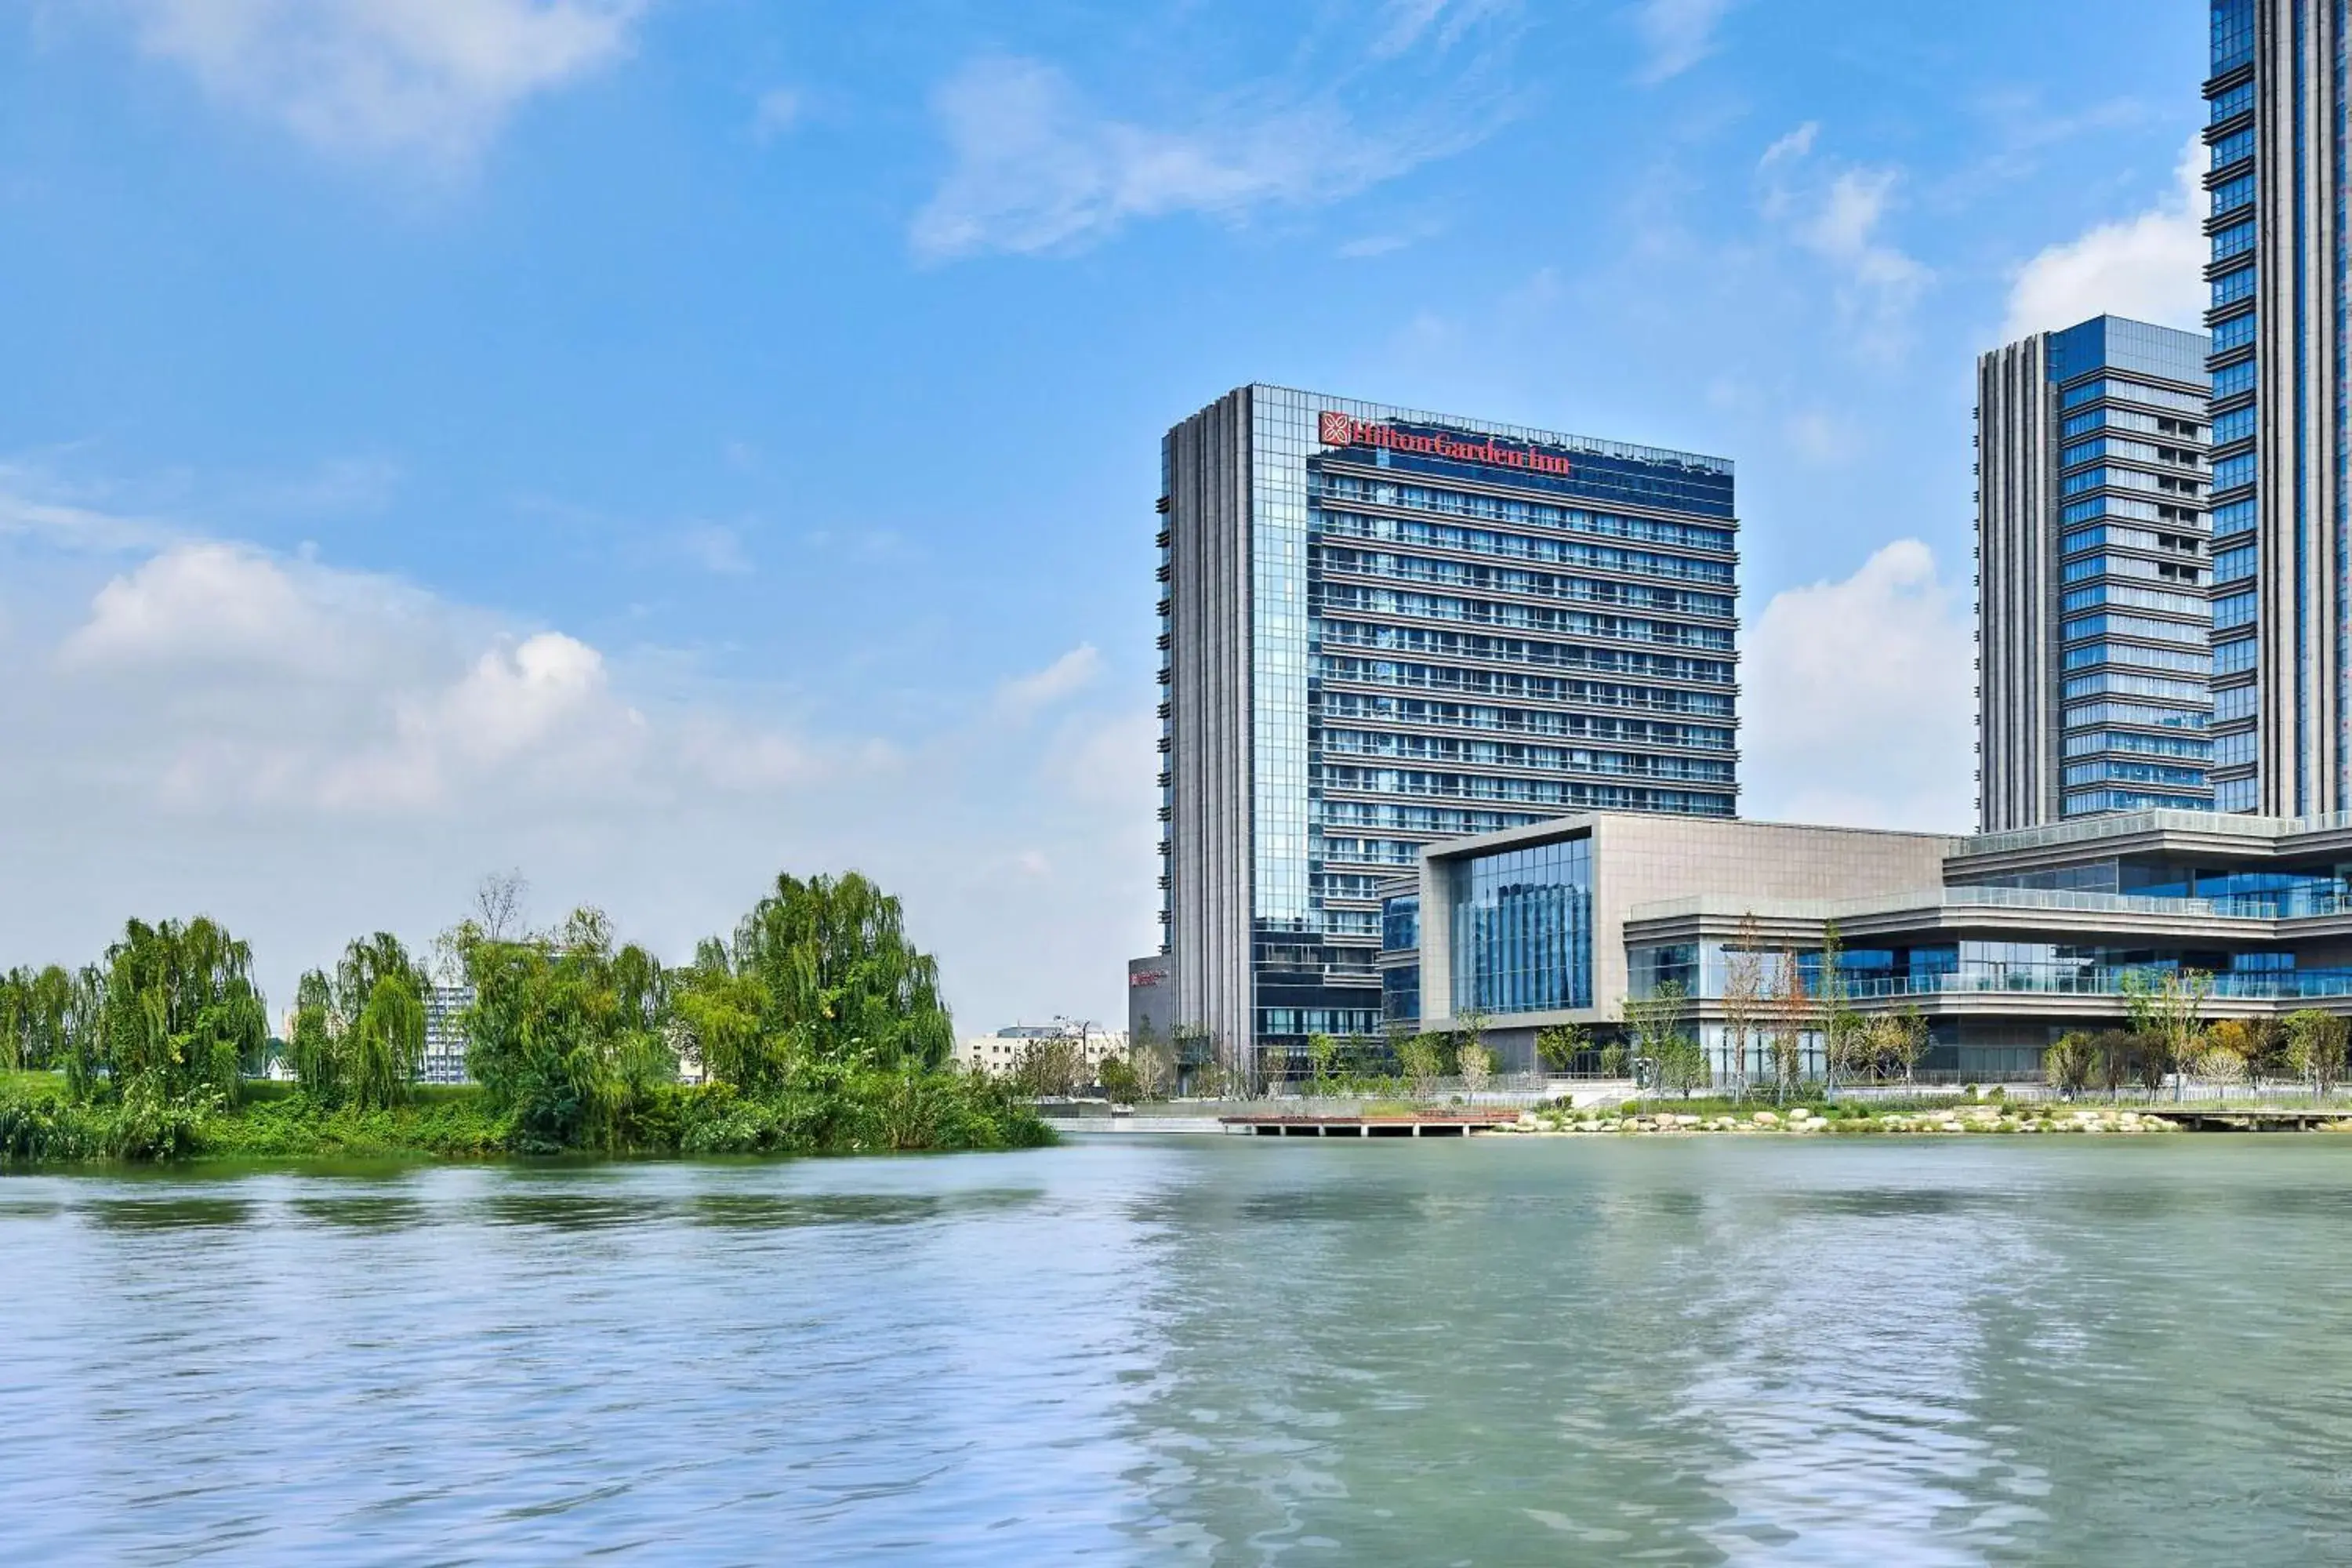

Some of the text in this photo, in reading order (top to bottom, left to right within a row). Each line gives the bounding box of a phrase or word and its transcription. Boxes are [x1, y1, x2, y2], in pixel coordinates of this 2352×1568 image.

[1352, 419, 1570, 474] Hilton Garden Inn
